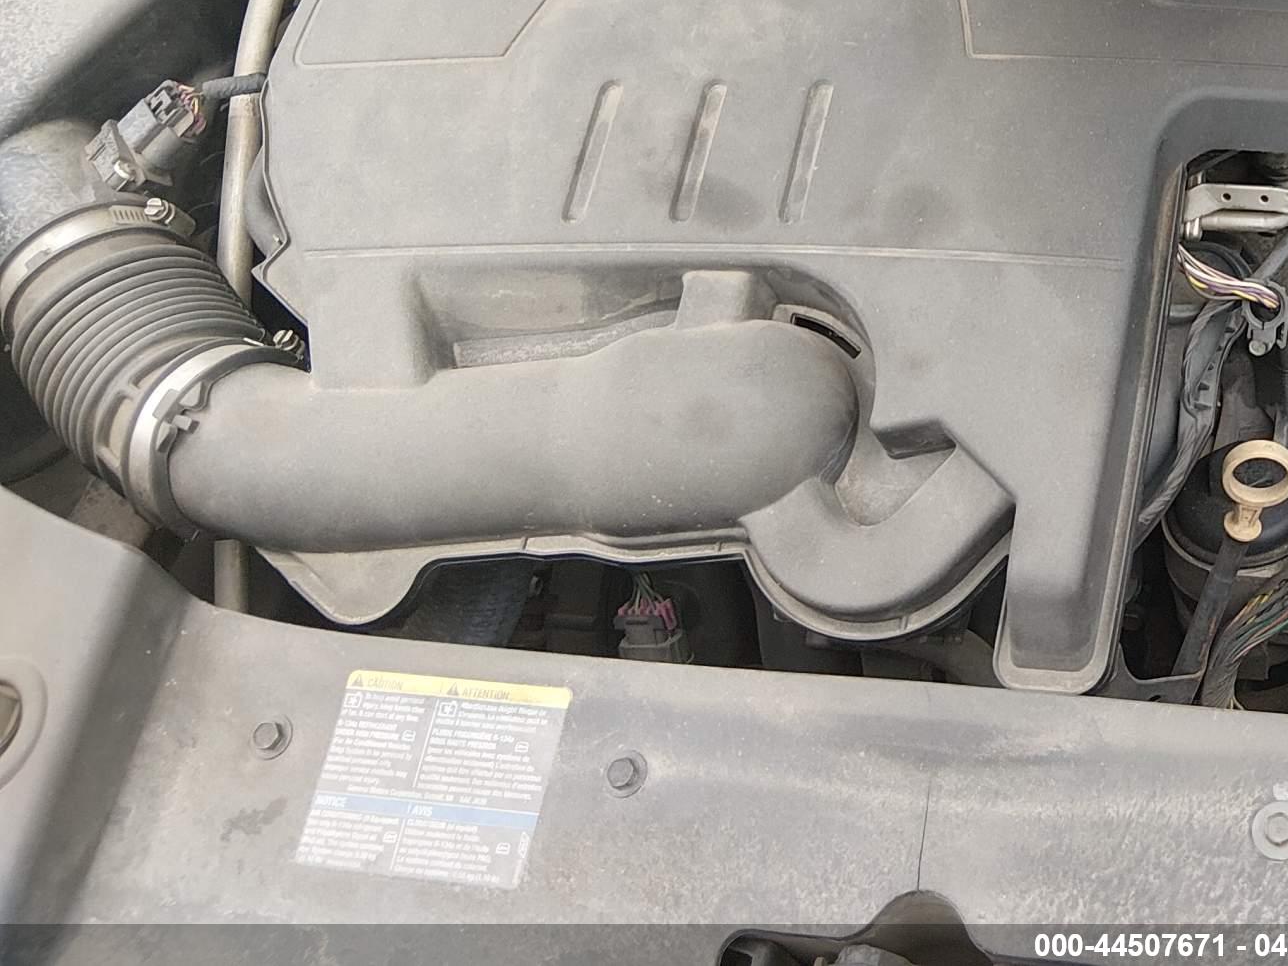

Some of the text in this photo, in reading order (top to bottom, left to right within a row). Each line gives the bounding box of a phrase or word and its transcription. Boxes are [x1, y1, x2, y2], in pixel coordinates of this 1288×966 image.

[367, 678, 404, 691] CAUTION
[462, 688, 510, 699] ATTENTION
[411, 805, 433, 816] AVIS
